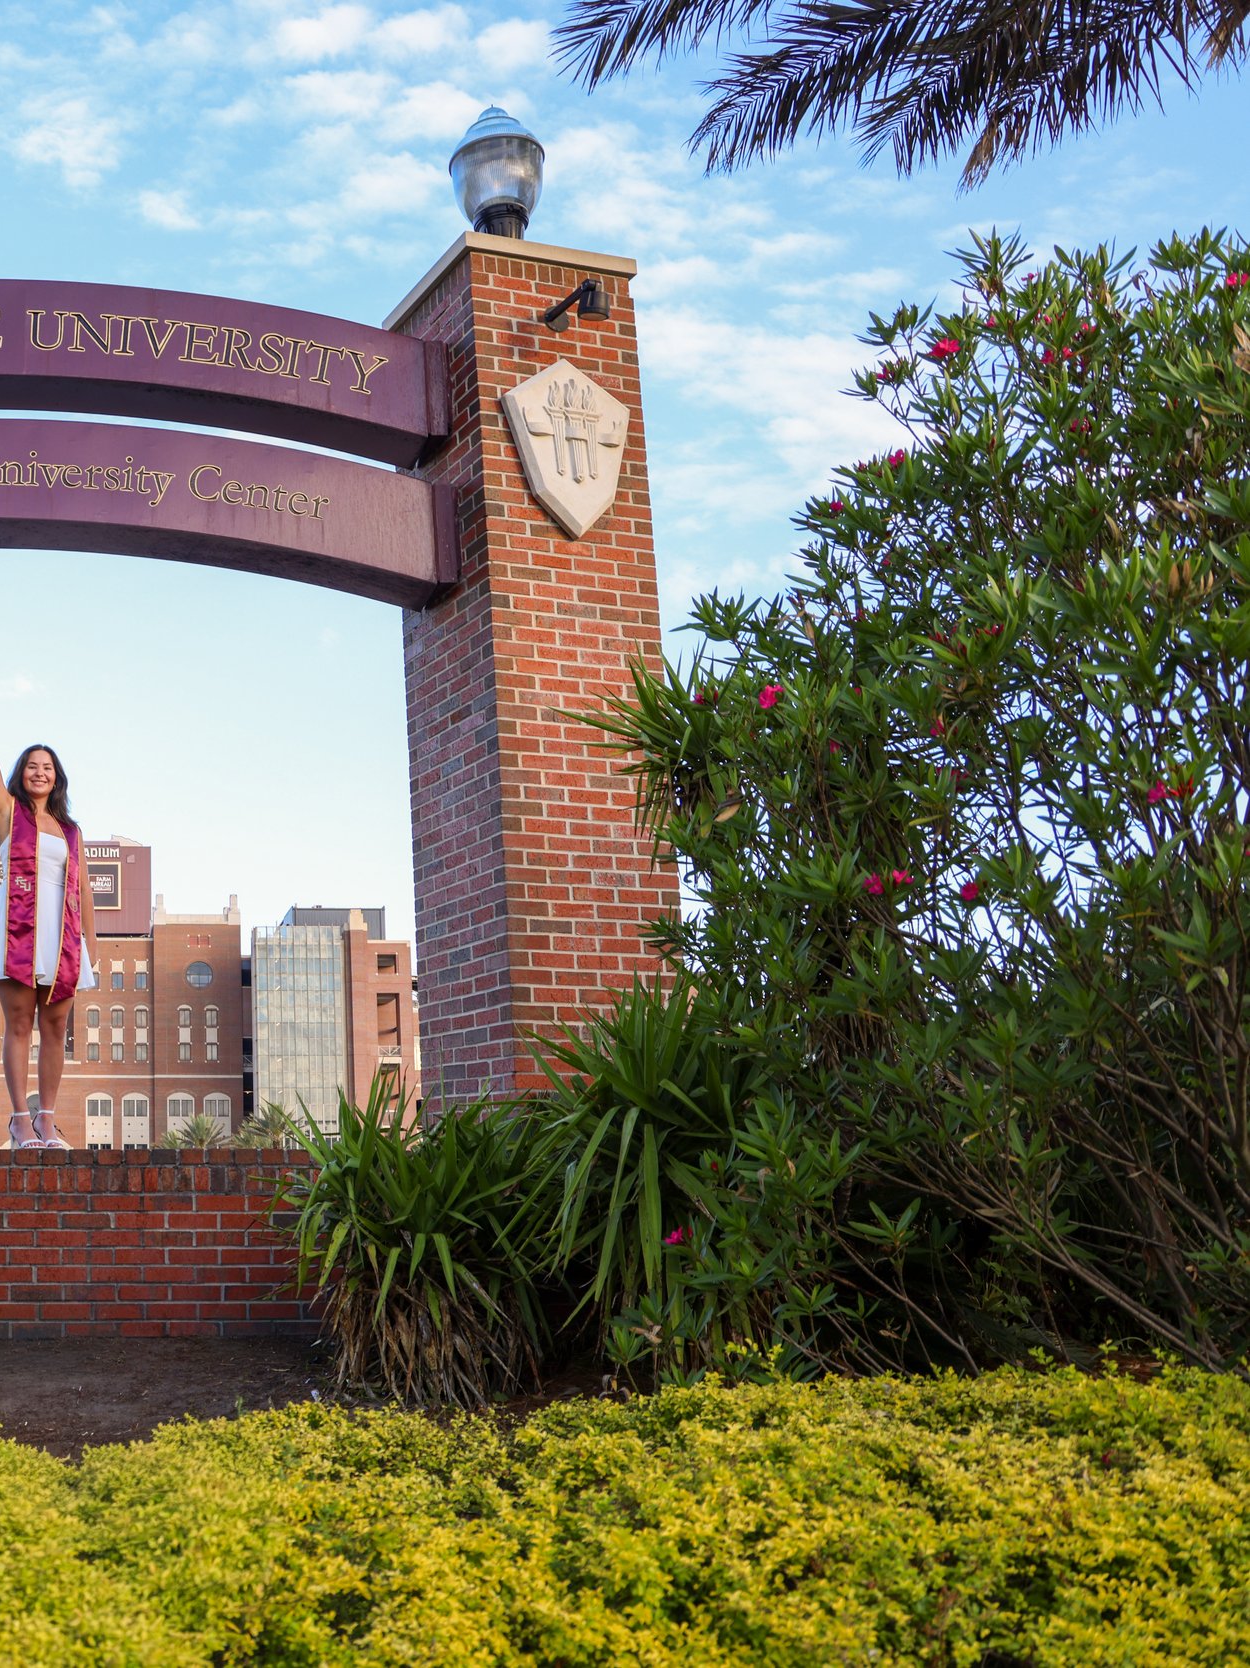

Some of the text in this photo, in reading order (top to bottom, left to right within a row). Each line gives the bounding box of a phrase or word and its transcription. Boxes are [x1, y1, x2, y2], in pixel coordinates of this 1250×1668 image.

[27, 309, 389, 395] UNIVERSITY
[187, 463, 330, 521] Center
[84, 847, 120, 858] ADIUM
[15, 876, 31, 892] FSU
